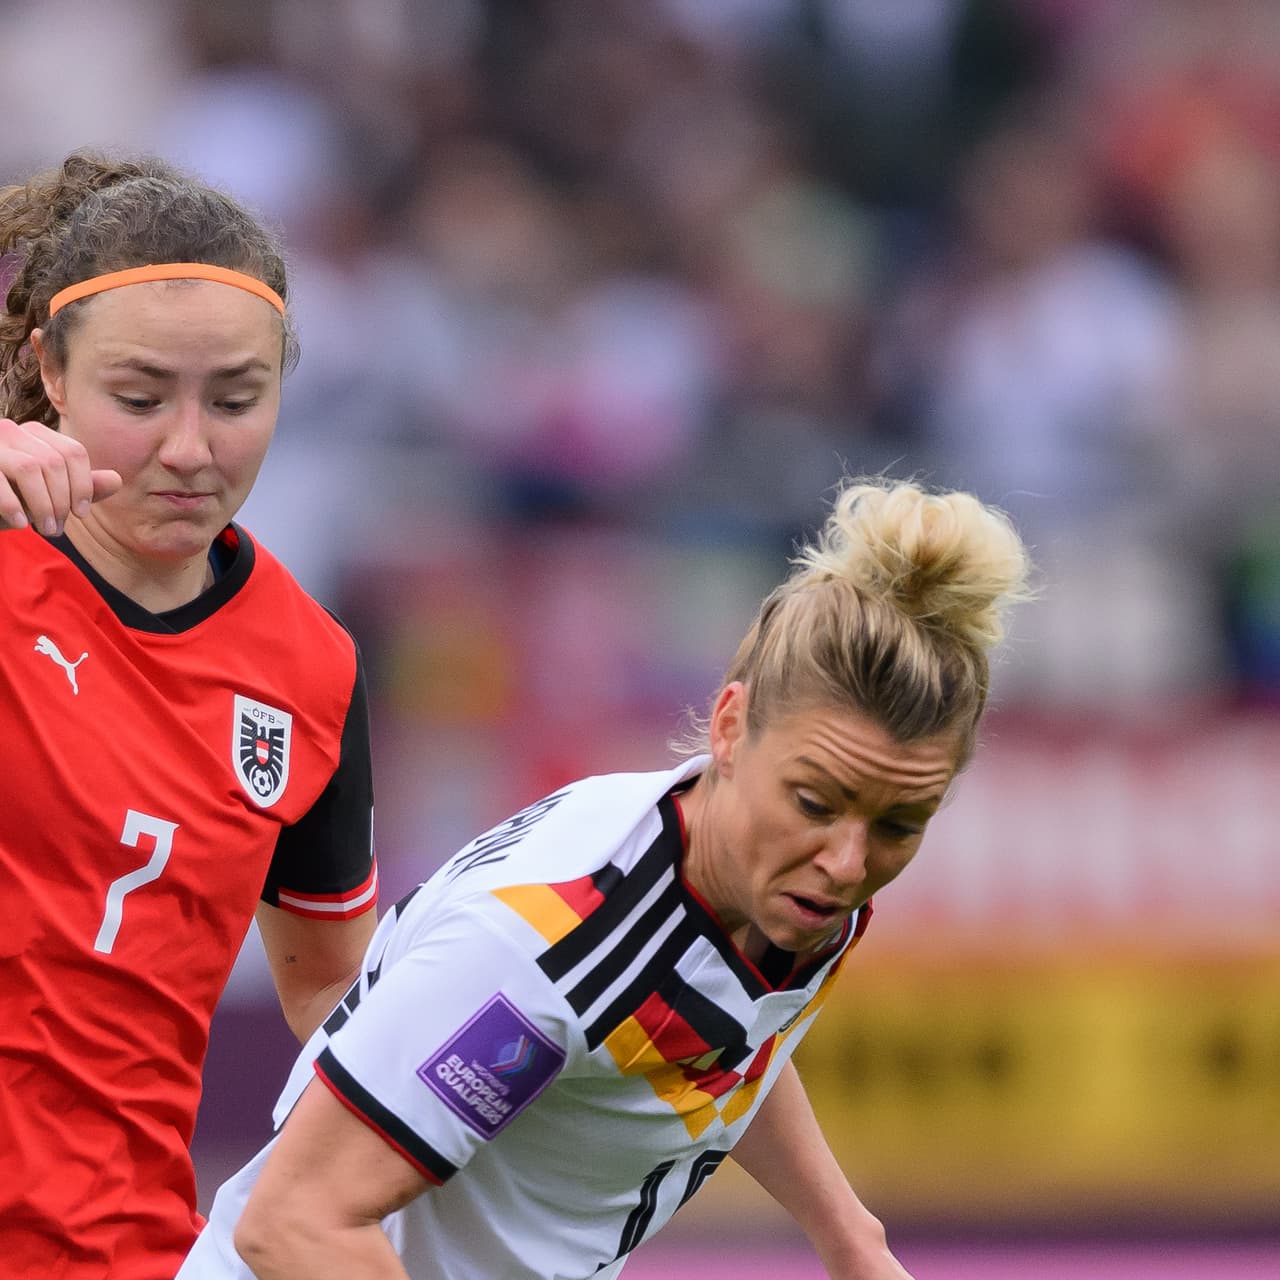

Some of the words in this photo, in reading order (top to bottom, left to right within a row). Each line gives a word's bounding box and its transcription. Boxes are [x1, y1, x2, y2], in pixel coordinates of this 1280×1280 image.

[252, 706, 276, 724] ÖFB
[93, 808, 180, 955] 7
[435, 1062, 504, 1126] QUALIFIERS
[445, 1053, 513, 1115] EUROPEAN
